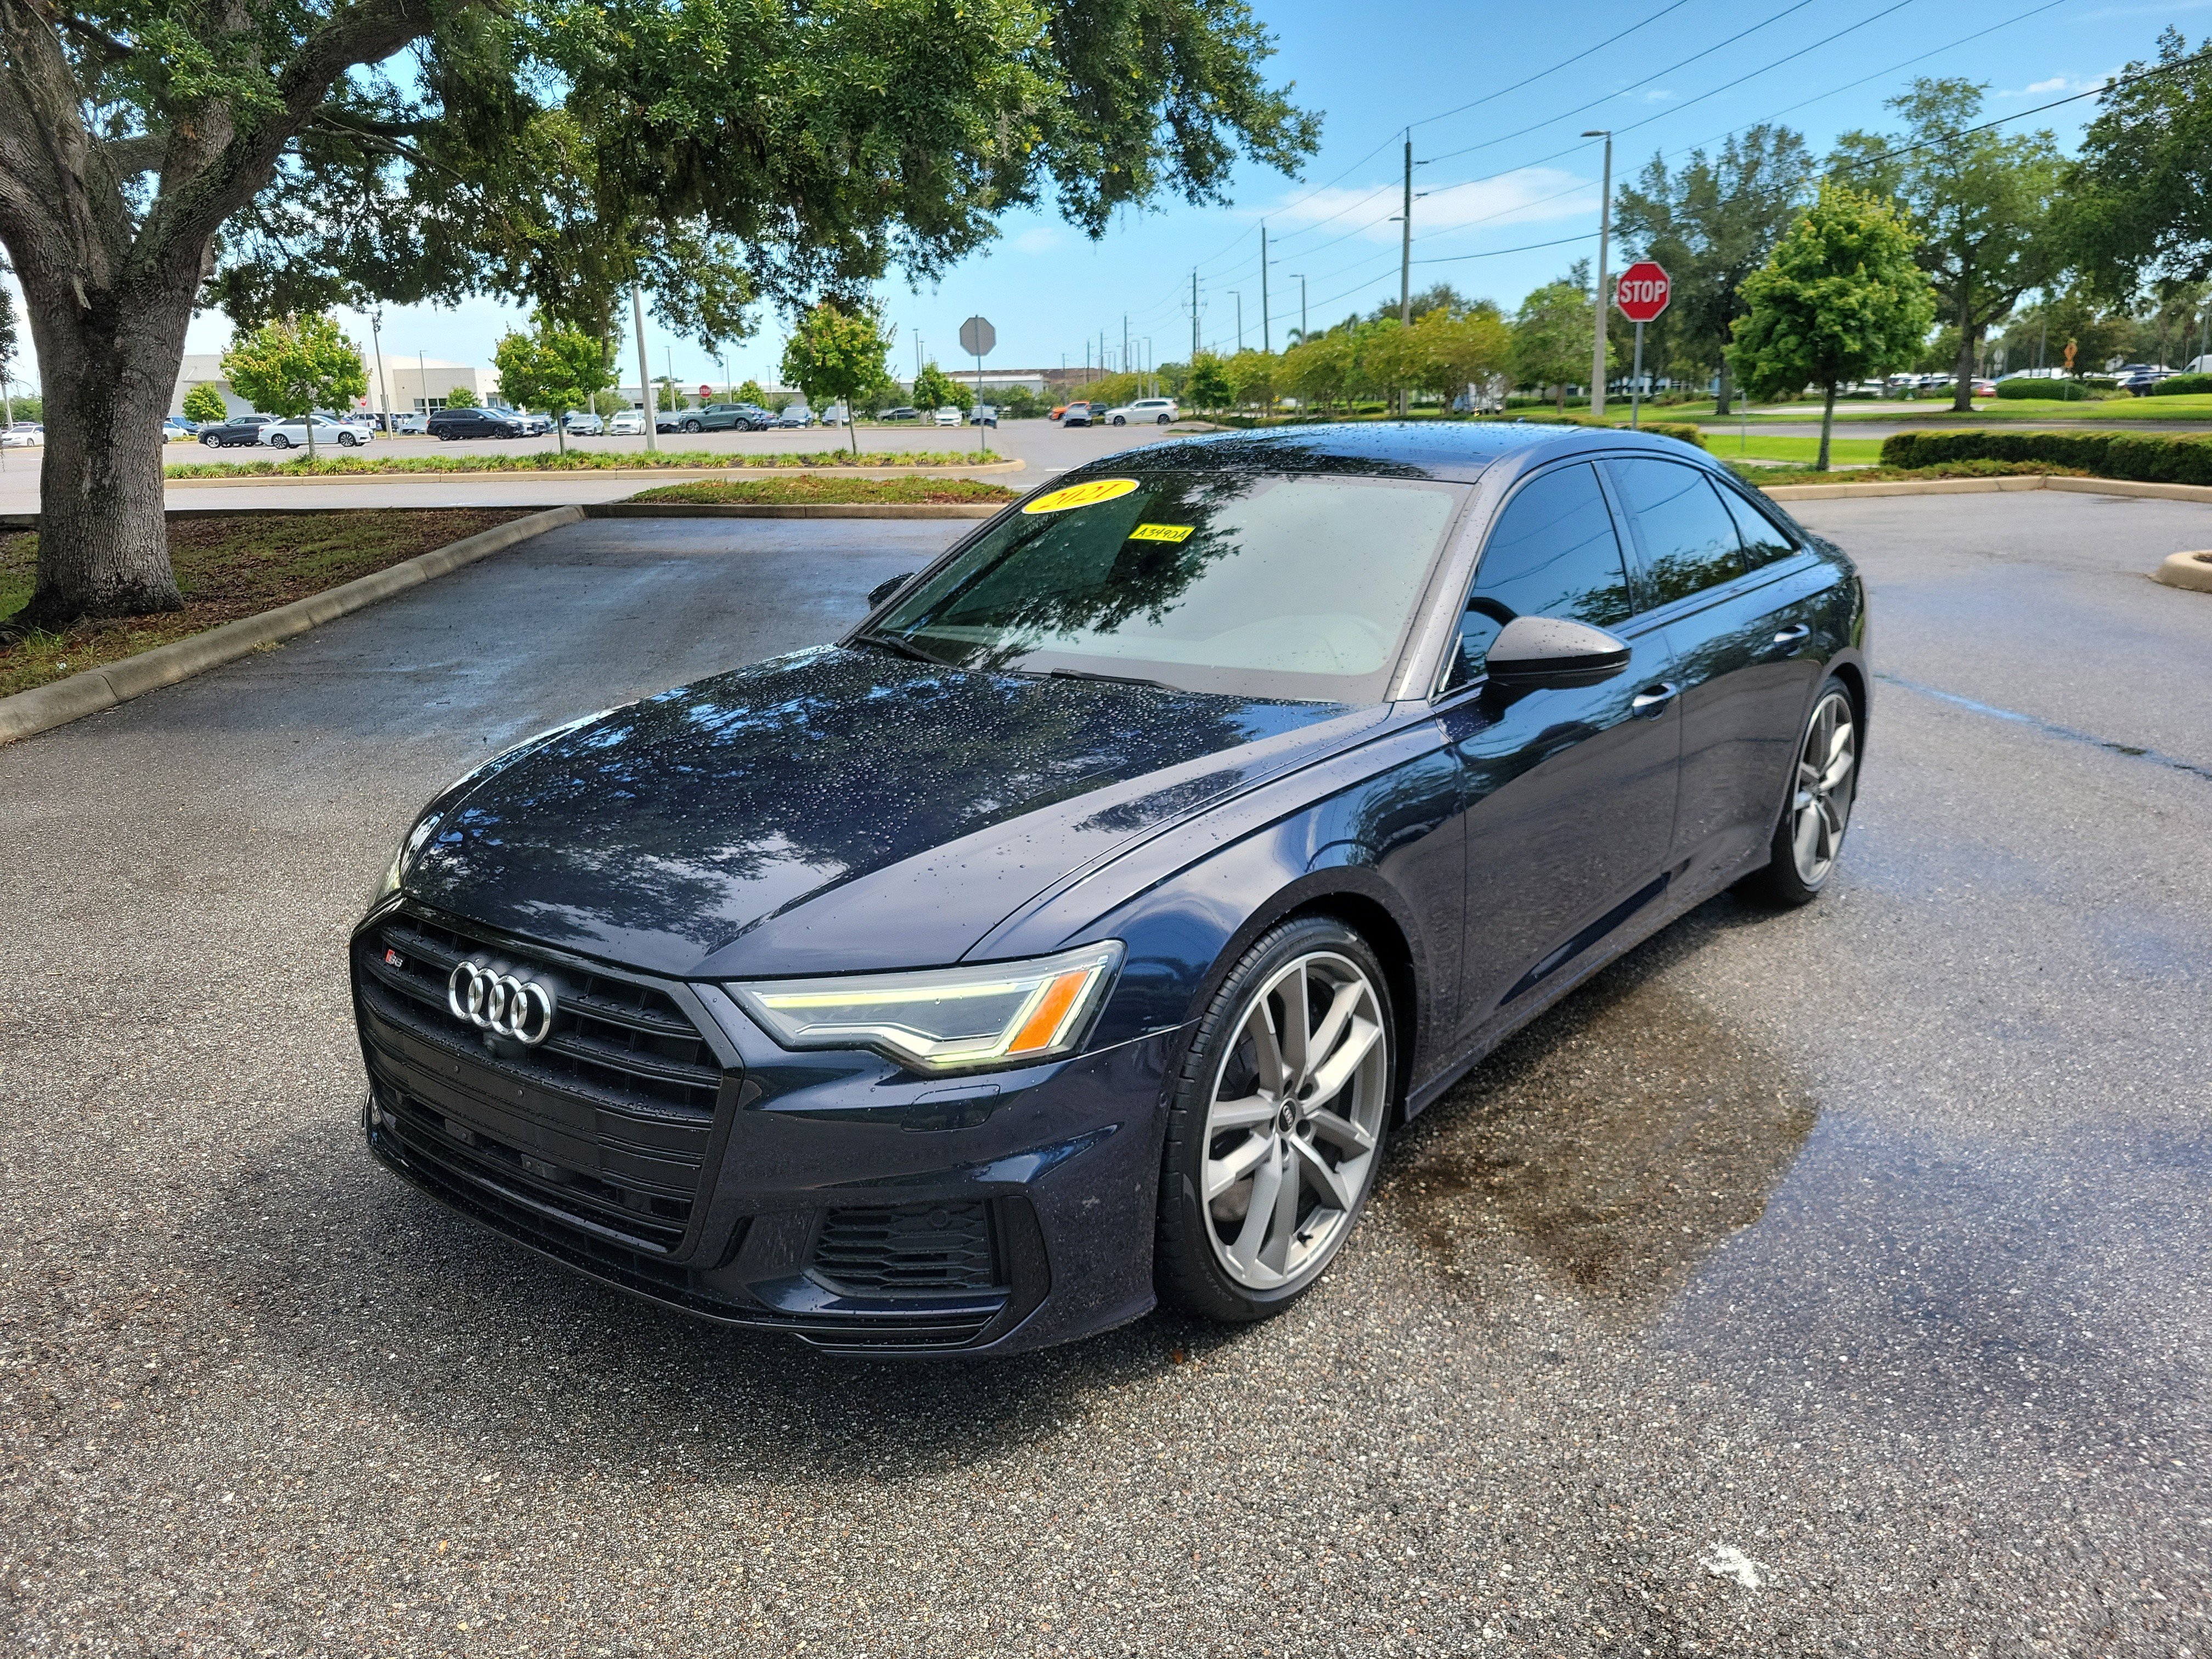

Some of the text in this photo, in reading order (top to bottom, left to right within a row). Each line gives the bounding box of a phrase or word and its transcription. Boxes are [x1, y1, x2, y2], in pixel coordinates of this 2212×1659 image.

[1620, 280, 1667, 303] STOP
[1036, 483, 1122, 509] 2021
[1133, 528, 1188, 540] A3490A
